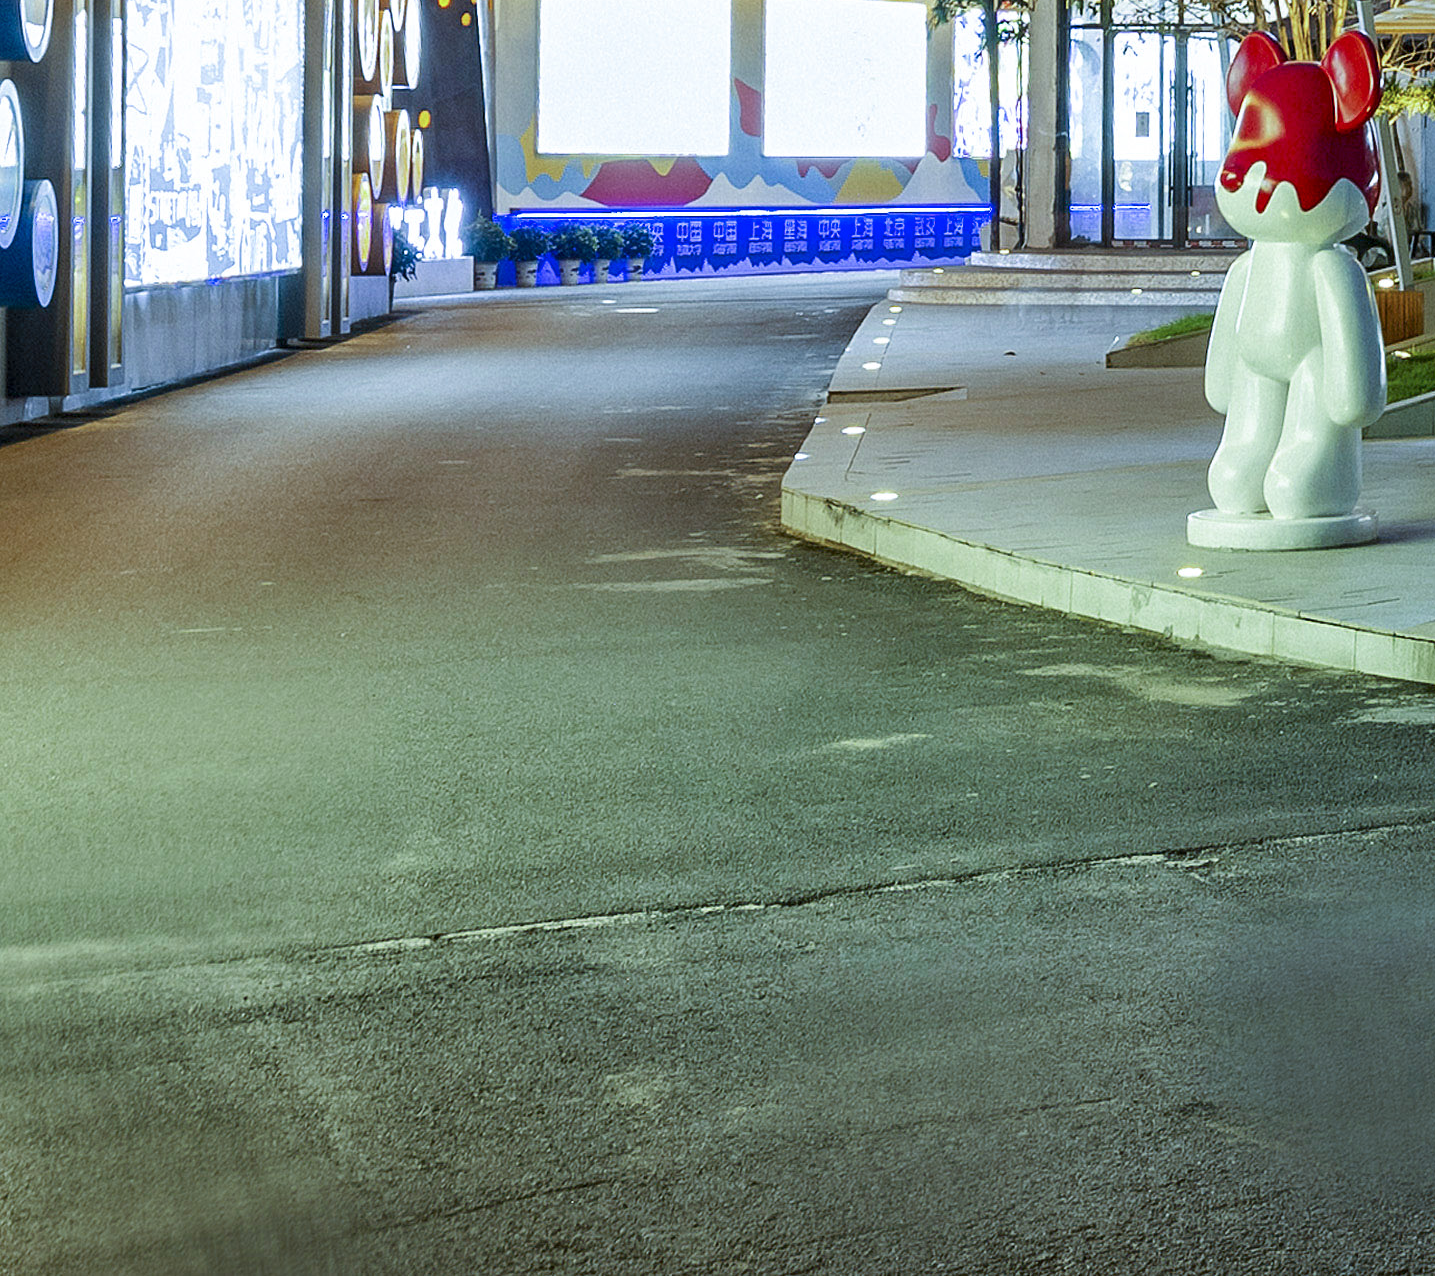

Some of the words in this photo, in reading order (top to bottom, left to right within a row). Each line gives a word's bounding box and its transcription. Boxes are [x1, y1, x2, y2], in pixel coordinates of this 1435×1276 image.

[677, 221, 701, 243] 中国
[713, 220, 737, 242] 中国
[818, 218, 841, 240] 中央
